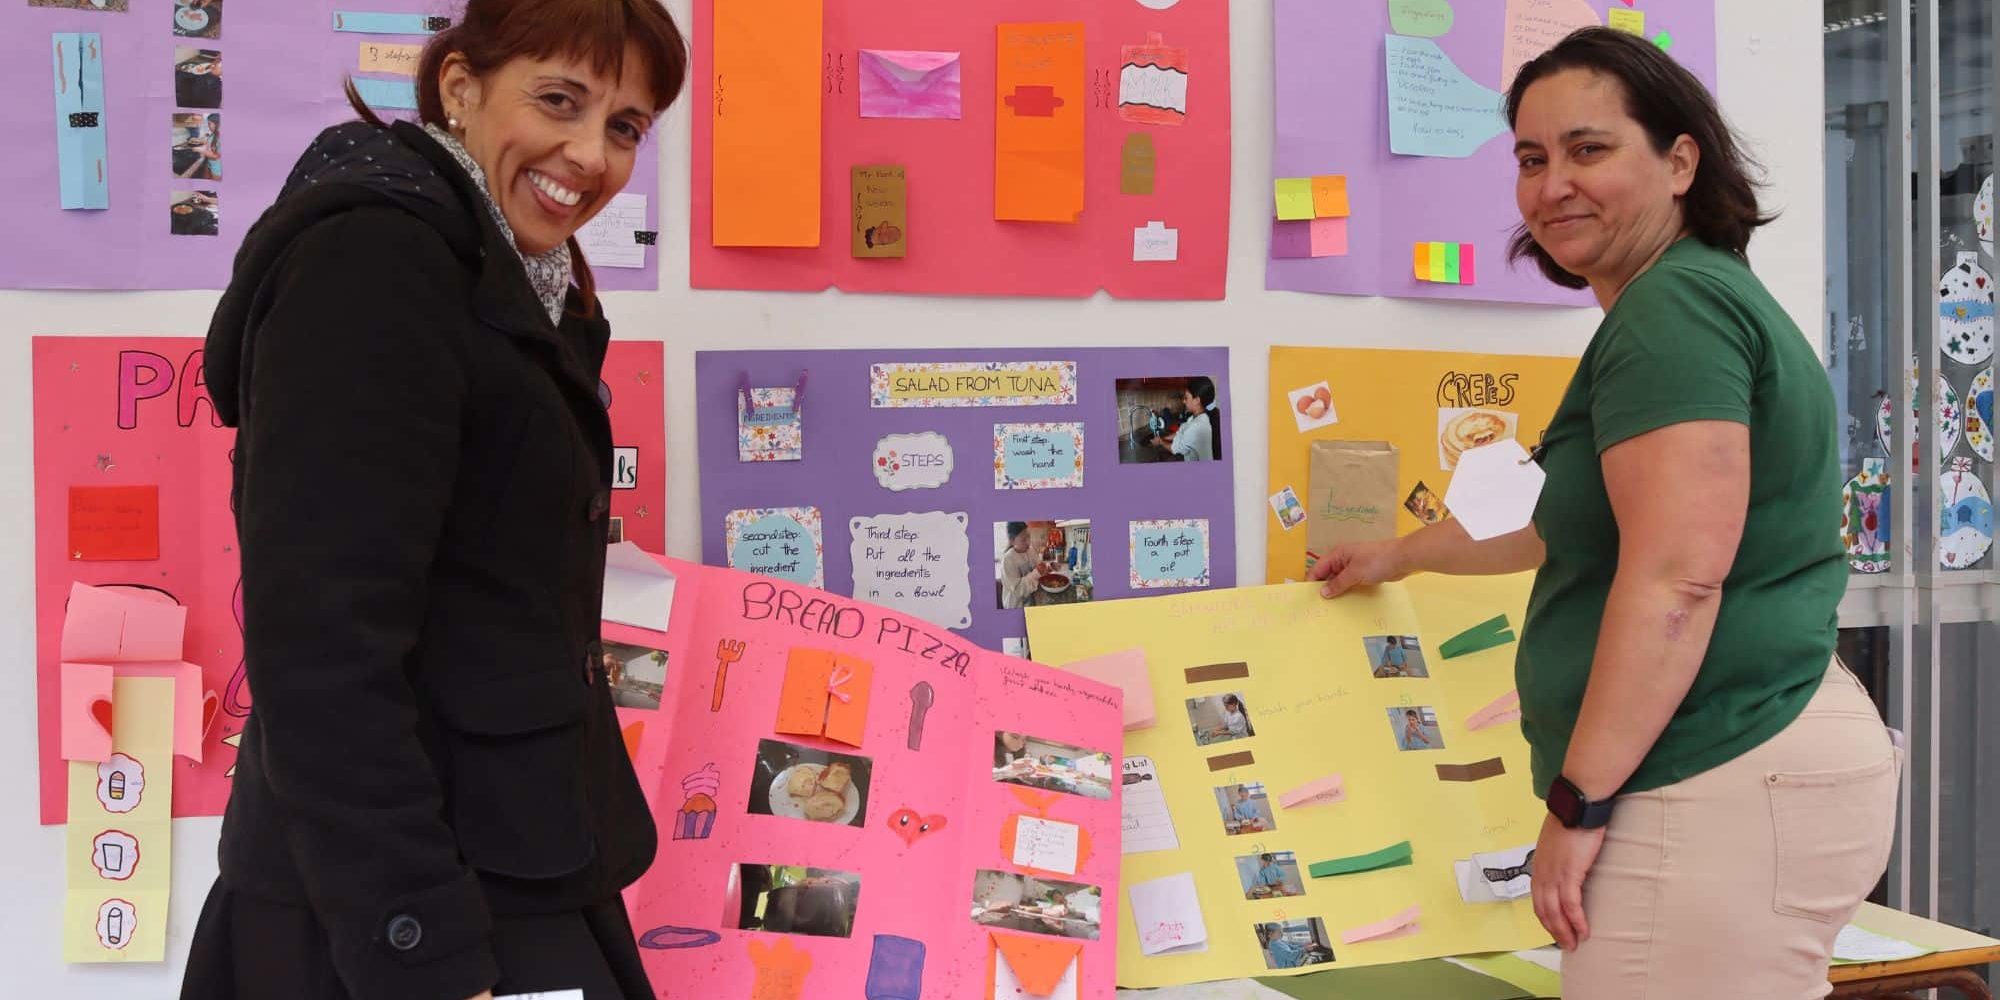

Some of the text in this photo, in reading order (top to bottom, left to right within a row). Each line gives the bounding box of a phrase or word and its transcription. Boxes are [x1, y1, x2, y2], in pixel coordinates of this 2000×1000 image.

[896, 375, 1057, 393] SALAD FROM TUNA
[1436, 370, 1519, 408] CREPES
[1012, 443, 1064, 456] wash the
[902, 453, 945, 467] STEPS
[1031, 458, 1055, 468] hand
[864, 525, 892, 540] Third
[752, 542, 800, 556] cut the
[866, 546, 942, 562] Put all the
[750, 559, 801, 575] ingredient
[876, 564, 931, 580] ingredients
[1160, 561, 1176, 573] oil
[869, 589, 879, 598] in
[743, 582, 865, 638] BREAD
